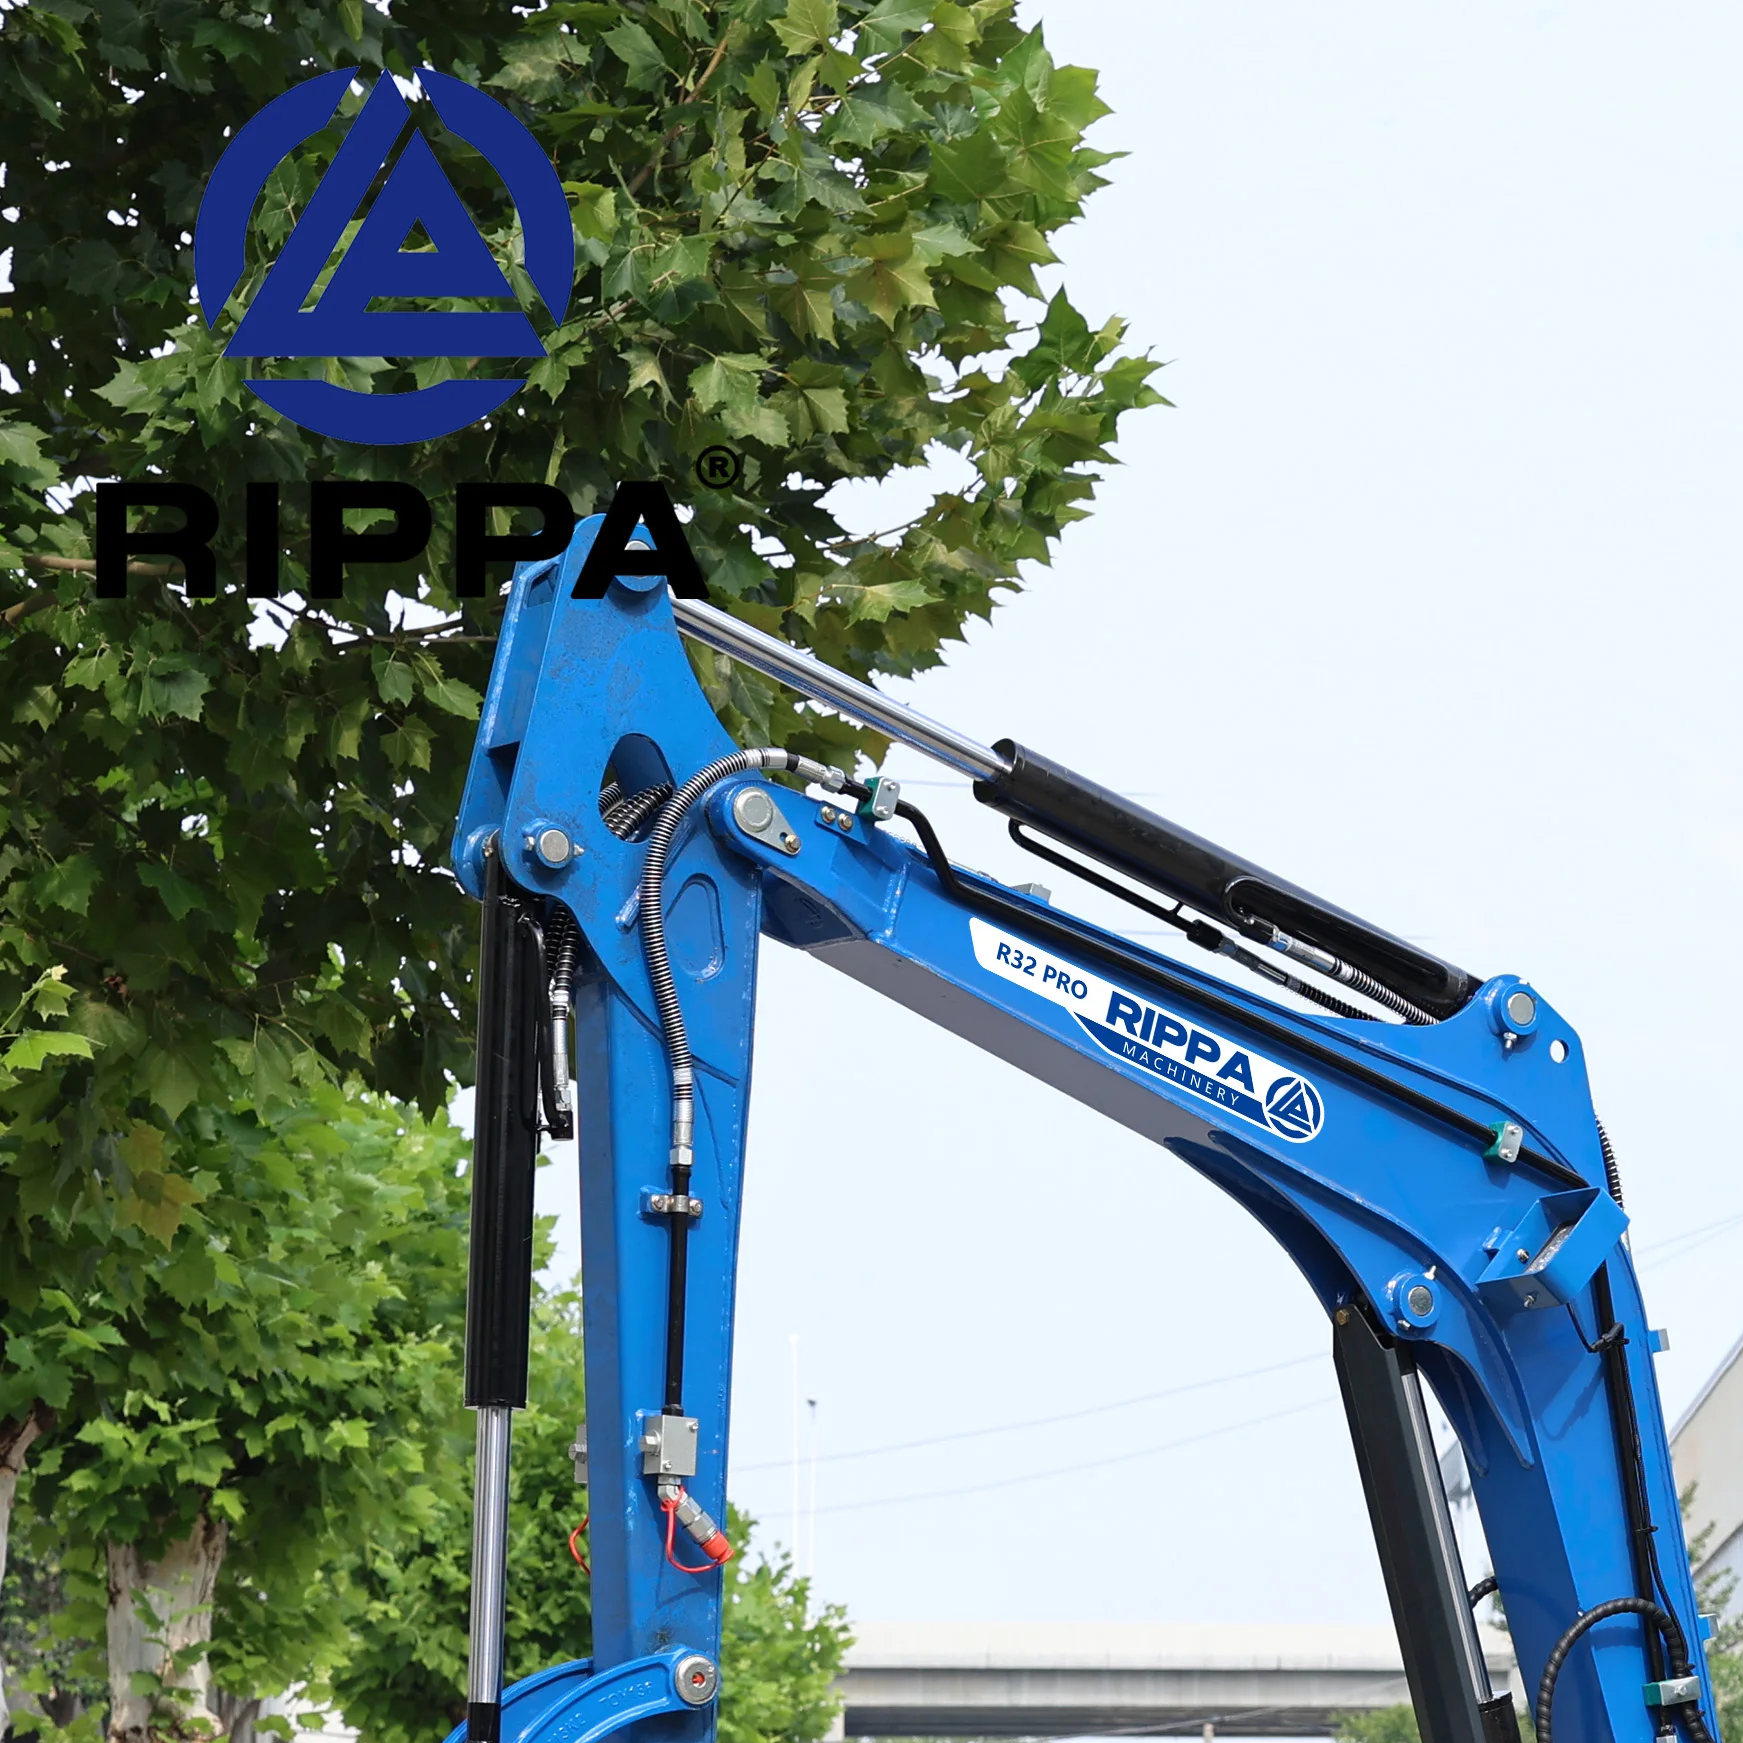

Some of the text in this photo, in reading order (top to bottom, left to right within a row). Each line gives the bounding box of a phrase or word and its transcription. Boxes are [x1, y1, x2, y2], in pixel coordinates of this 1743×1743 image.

[996, 942, 1089, 1000] R32 PRO
[1105, 990, 1256, 1094] RIPPA
[1121, 1040, 1240, 1107] MACHINERY
